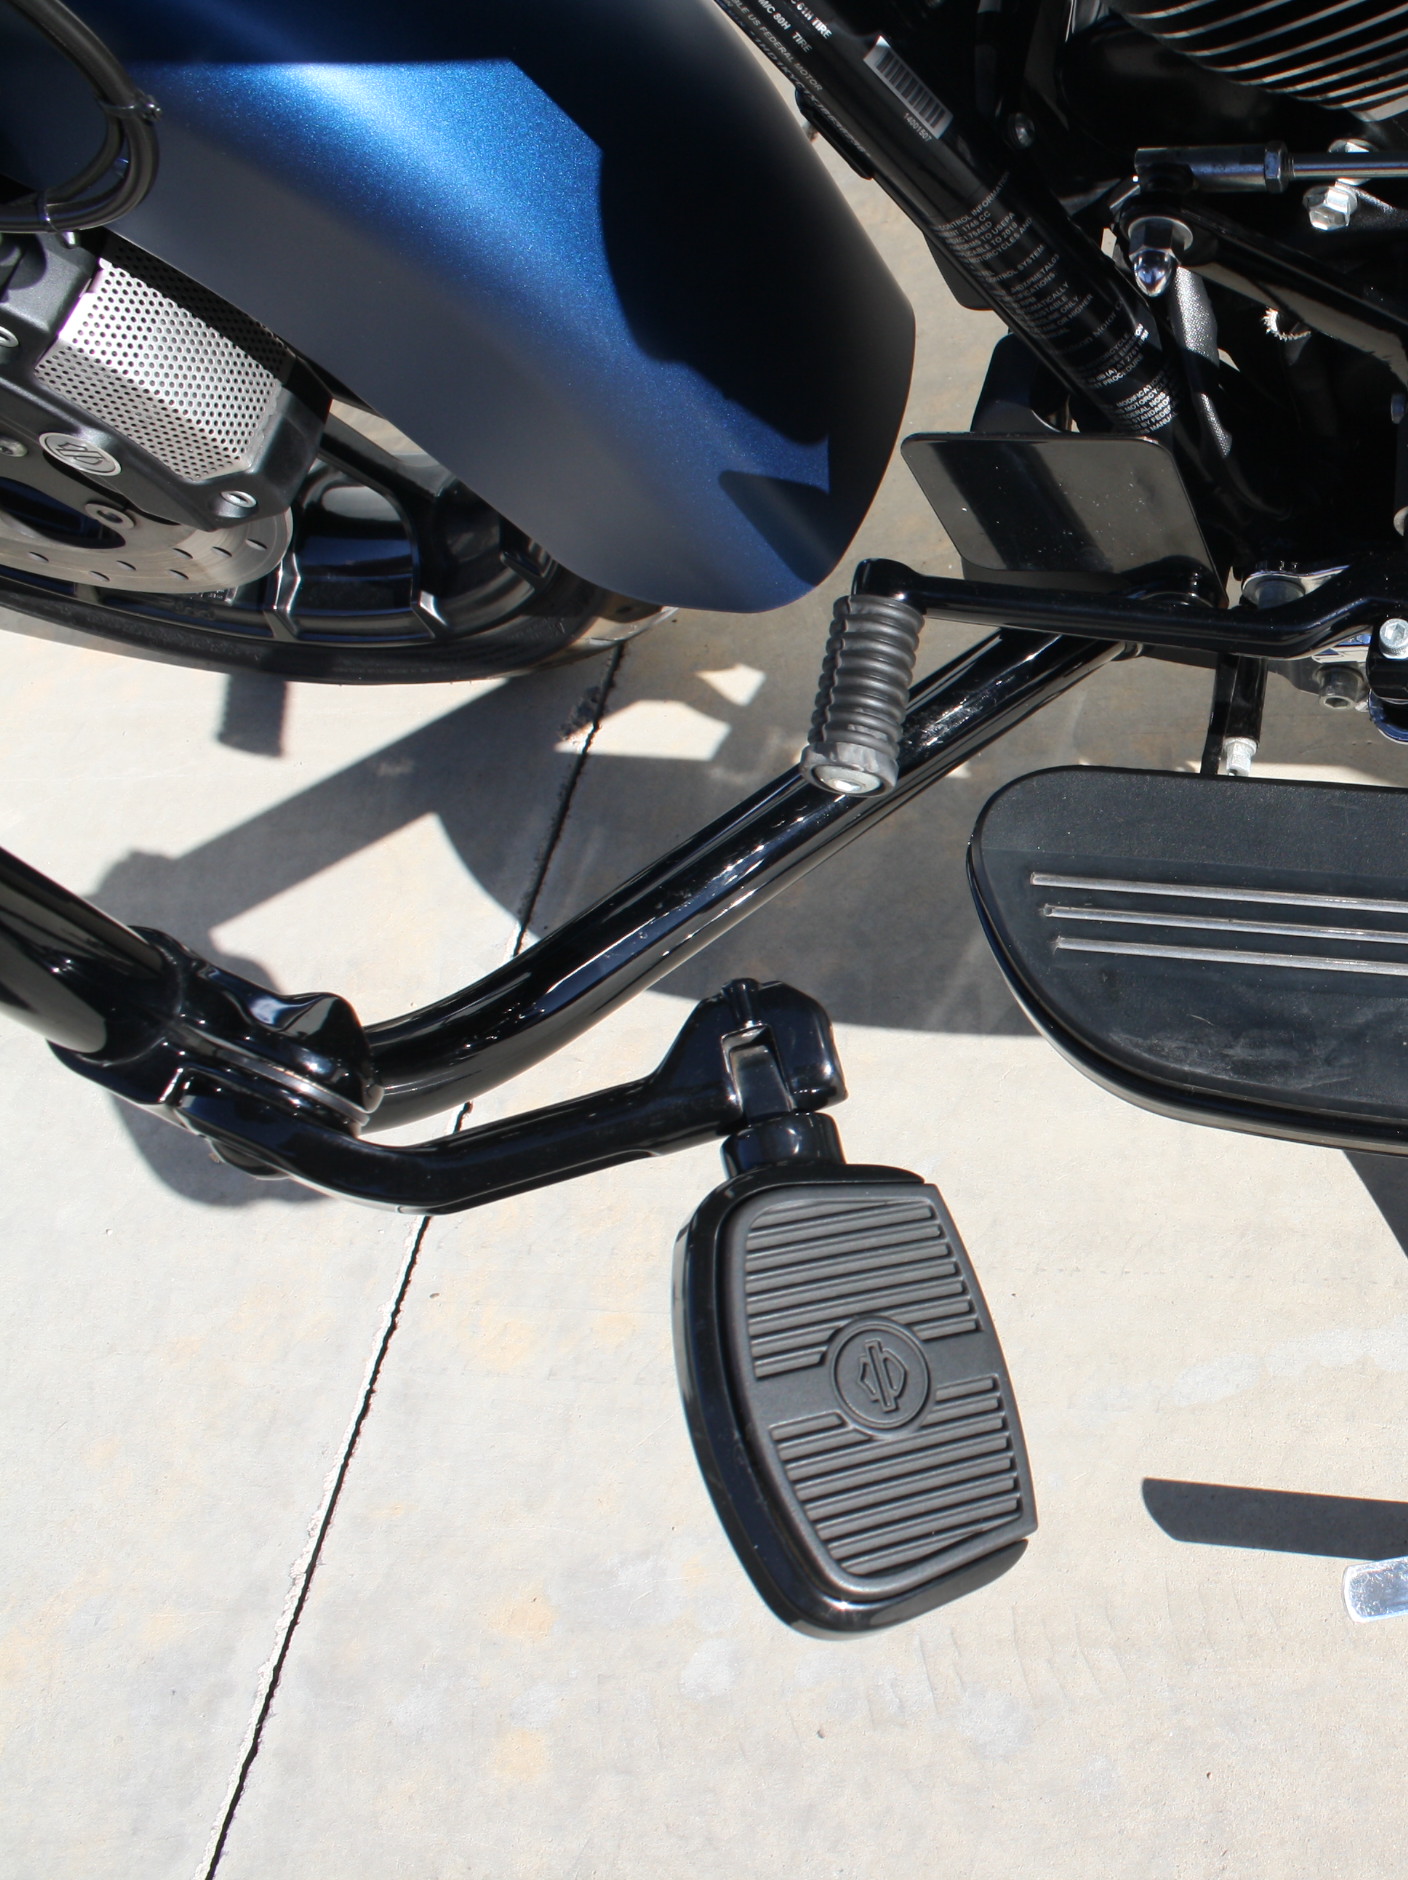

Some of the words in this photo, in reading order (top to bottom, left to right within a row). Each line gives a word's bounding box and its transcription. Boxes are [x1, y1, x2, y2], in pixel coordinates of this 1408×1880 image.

[812, 17, 833, 40] TIRE
[747, 13, 762, 27] US
[759, 25, 795, 64] FEDERAL
[794, 62, 823, 91] MOTOR
[791, 30, 814, 53] TIRE
